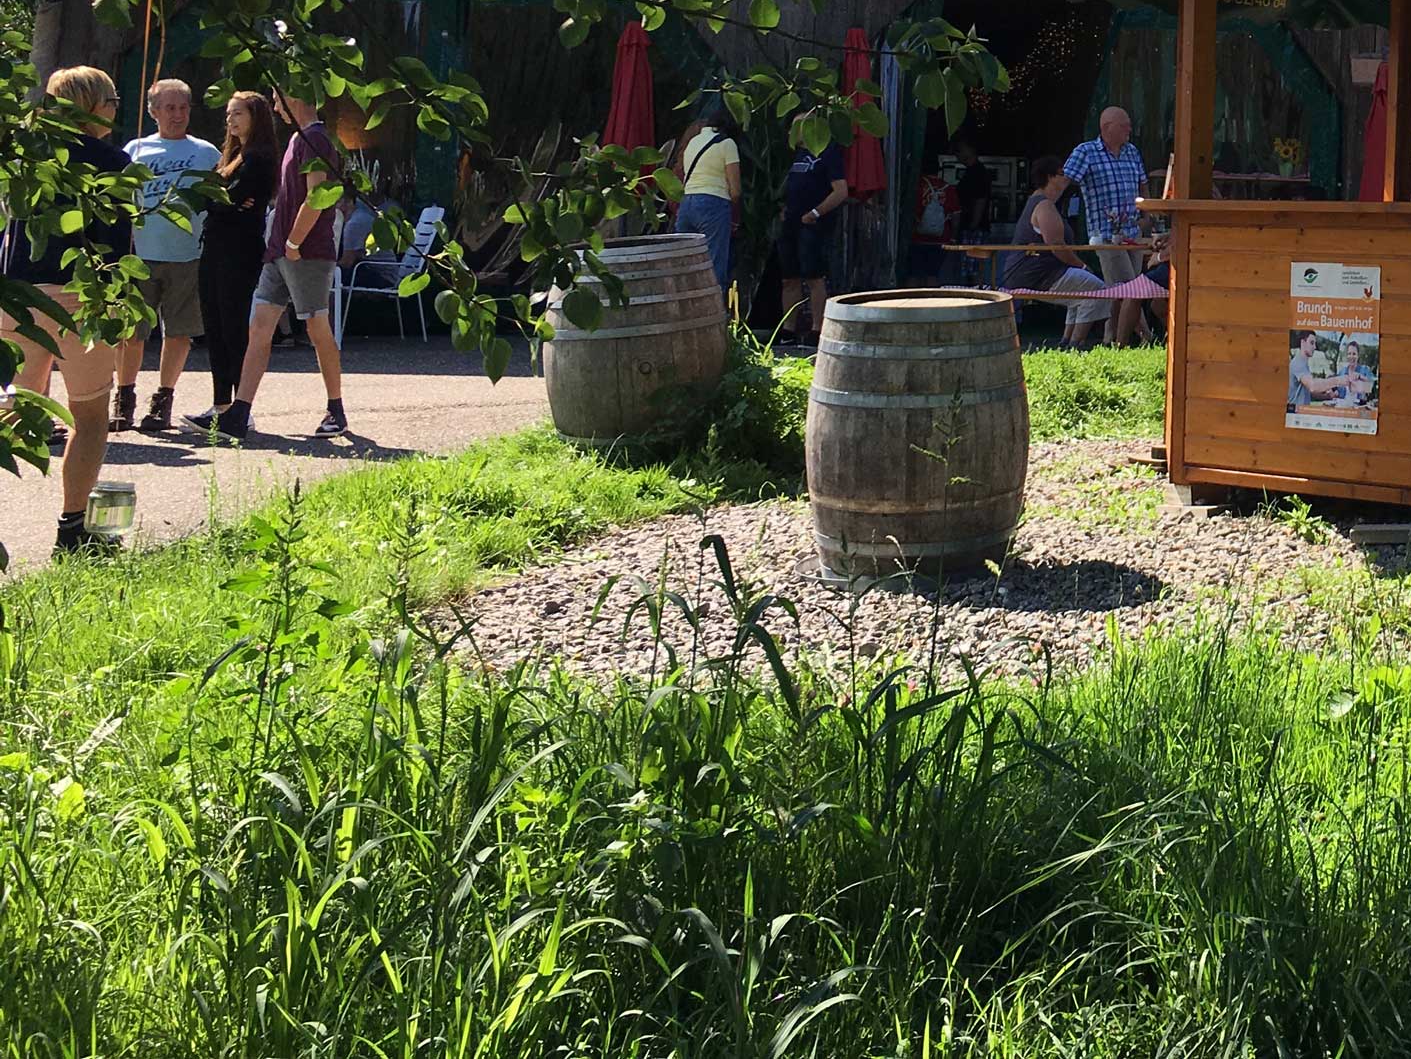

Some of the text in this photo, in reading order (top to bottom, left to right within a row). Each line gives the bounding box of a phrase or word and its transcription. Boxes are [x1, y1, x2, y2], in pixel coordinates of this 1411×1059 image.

[1296, 301, 1333, 315] Brunch
[1296, 315, 1374, 329] auf dem Bauernhof
